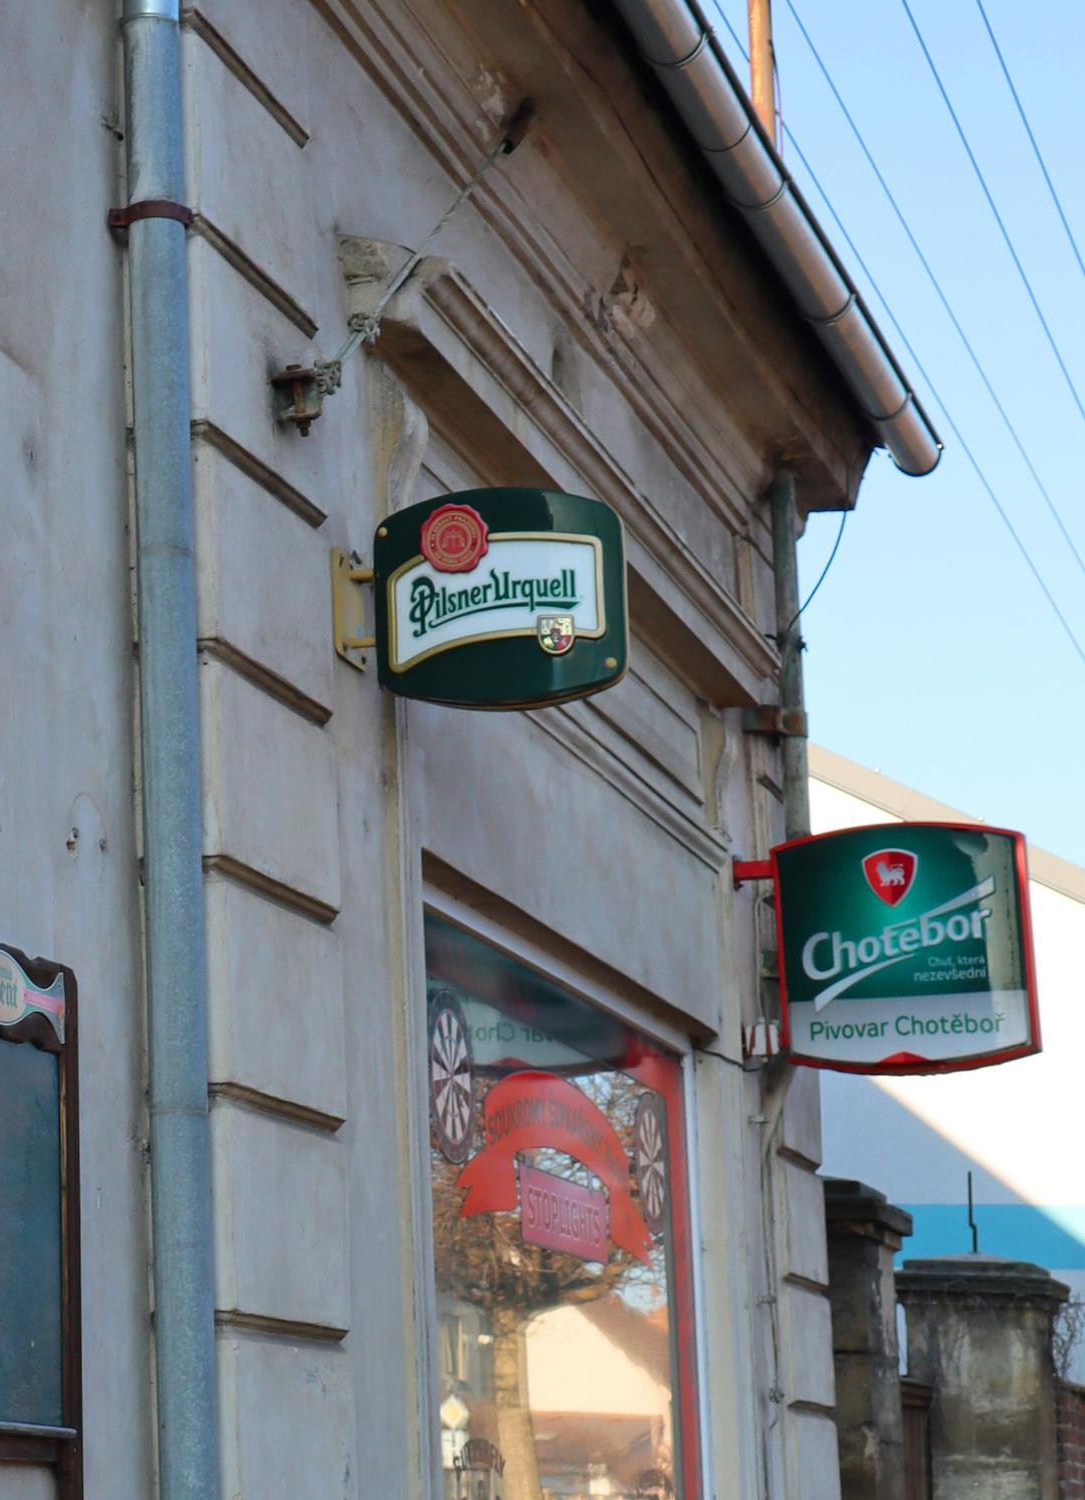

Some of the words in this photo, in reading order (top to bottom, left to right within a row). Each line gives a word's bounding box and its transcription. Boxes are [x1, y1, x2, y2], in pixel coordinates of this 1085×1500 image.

[409, 576, 492, 638] Pilsner
[490, 568, 577, 612] Urquell
[914, 965, 987, 983] nezevšední
[957, 953, 986, 966] která
[810, 1020, 889, 1042] Pivovar
[894, 1012, 1006, 1037] Chotěboř
[527, 1186, 602, 1247] STOPLIGHTS
